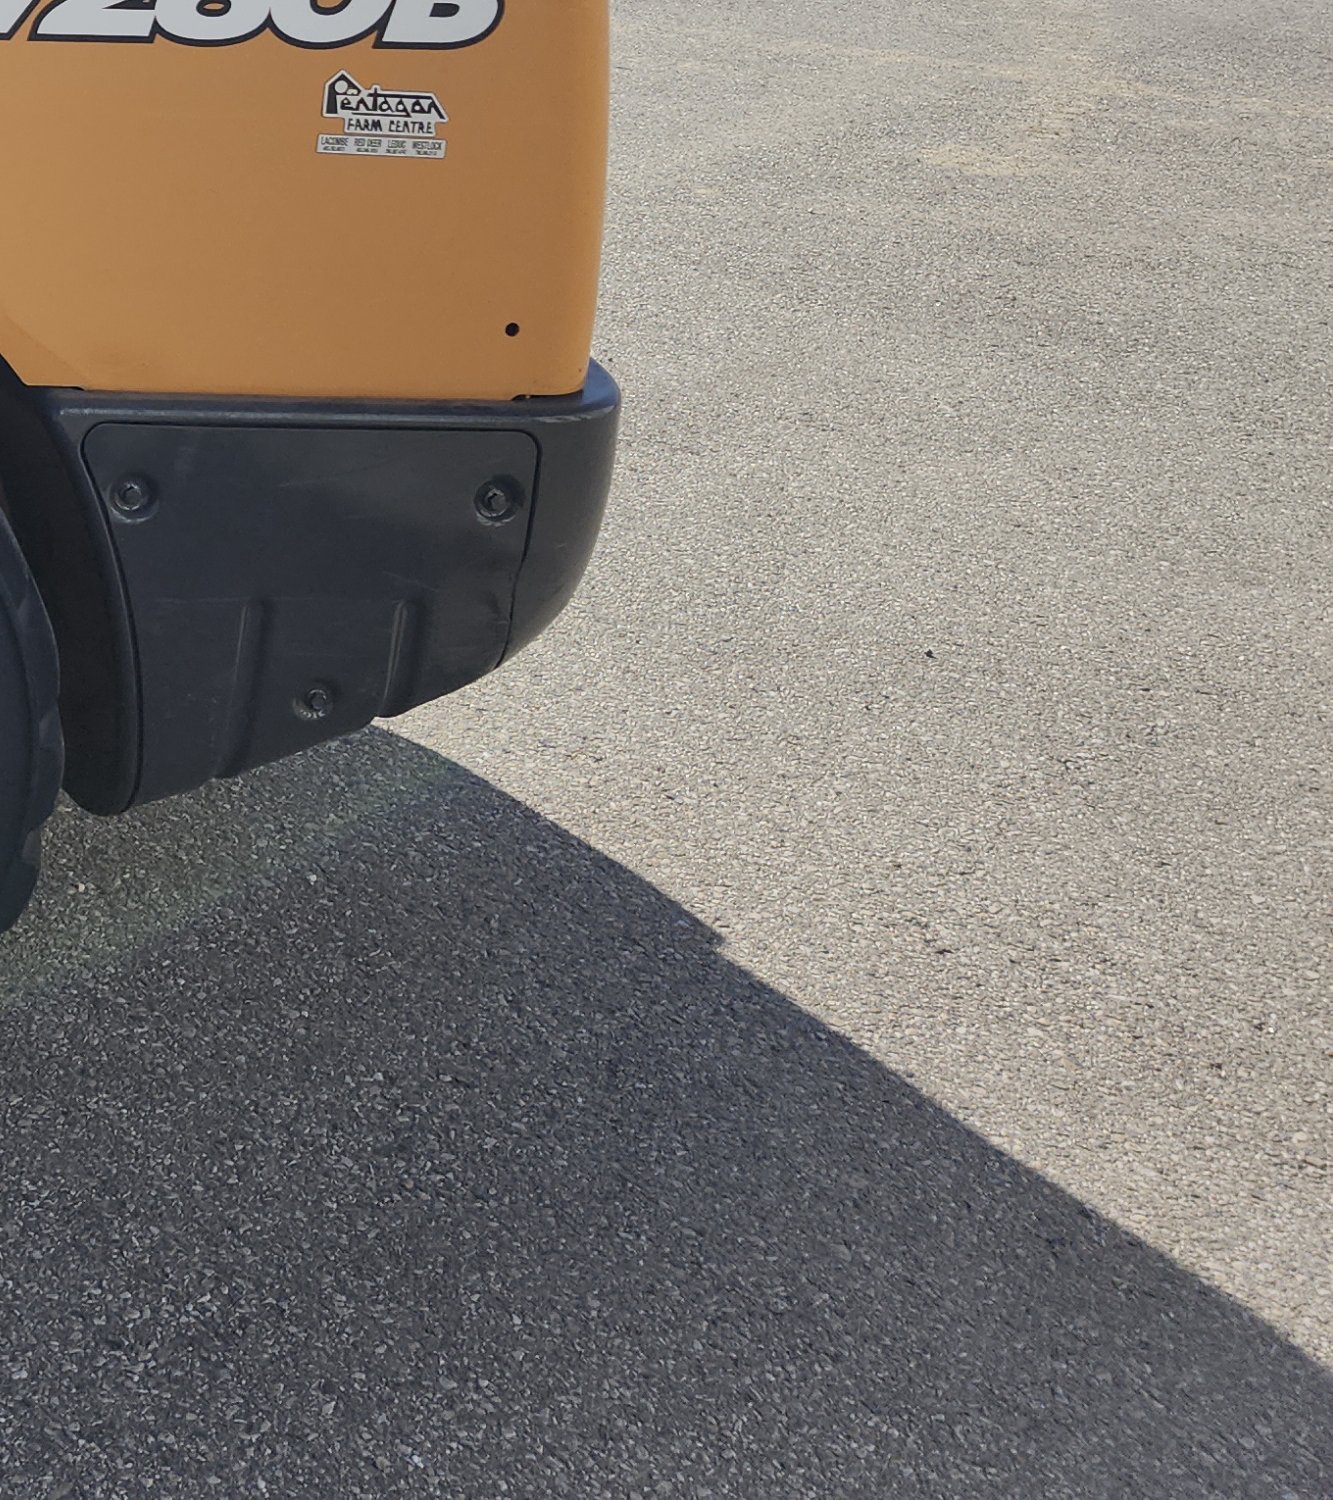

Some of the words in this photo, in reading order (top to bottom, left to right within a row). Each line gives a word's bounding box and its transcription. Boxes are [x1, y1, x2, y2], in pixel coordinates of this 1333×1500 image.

[347, 118, 383, 132] FARM
[388, 119, 434, 134] CENTRE
[321, 136, 349, 147] LACOMBE
[387, 139, 407, 149] LEDUC
[412, 140, 442, 151] WESTLOCK
